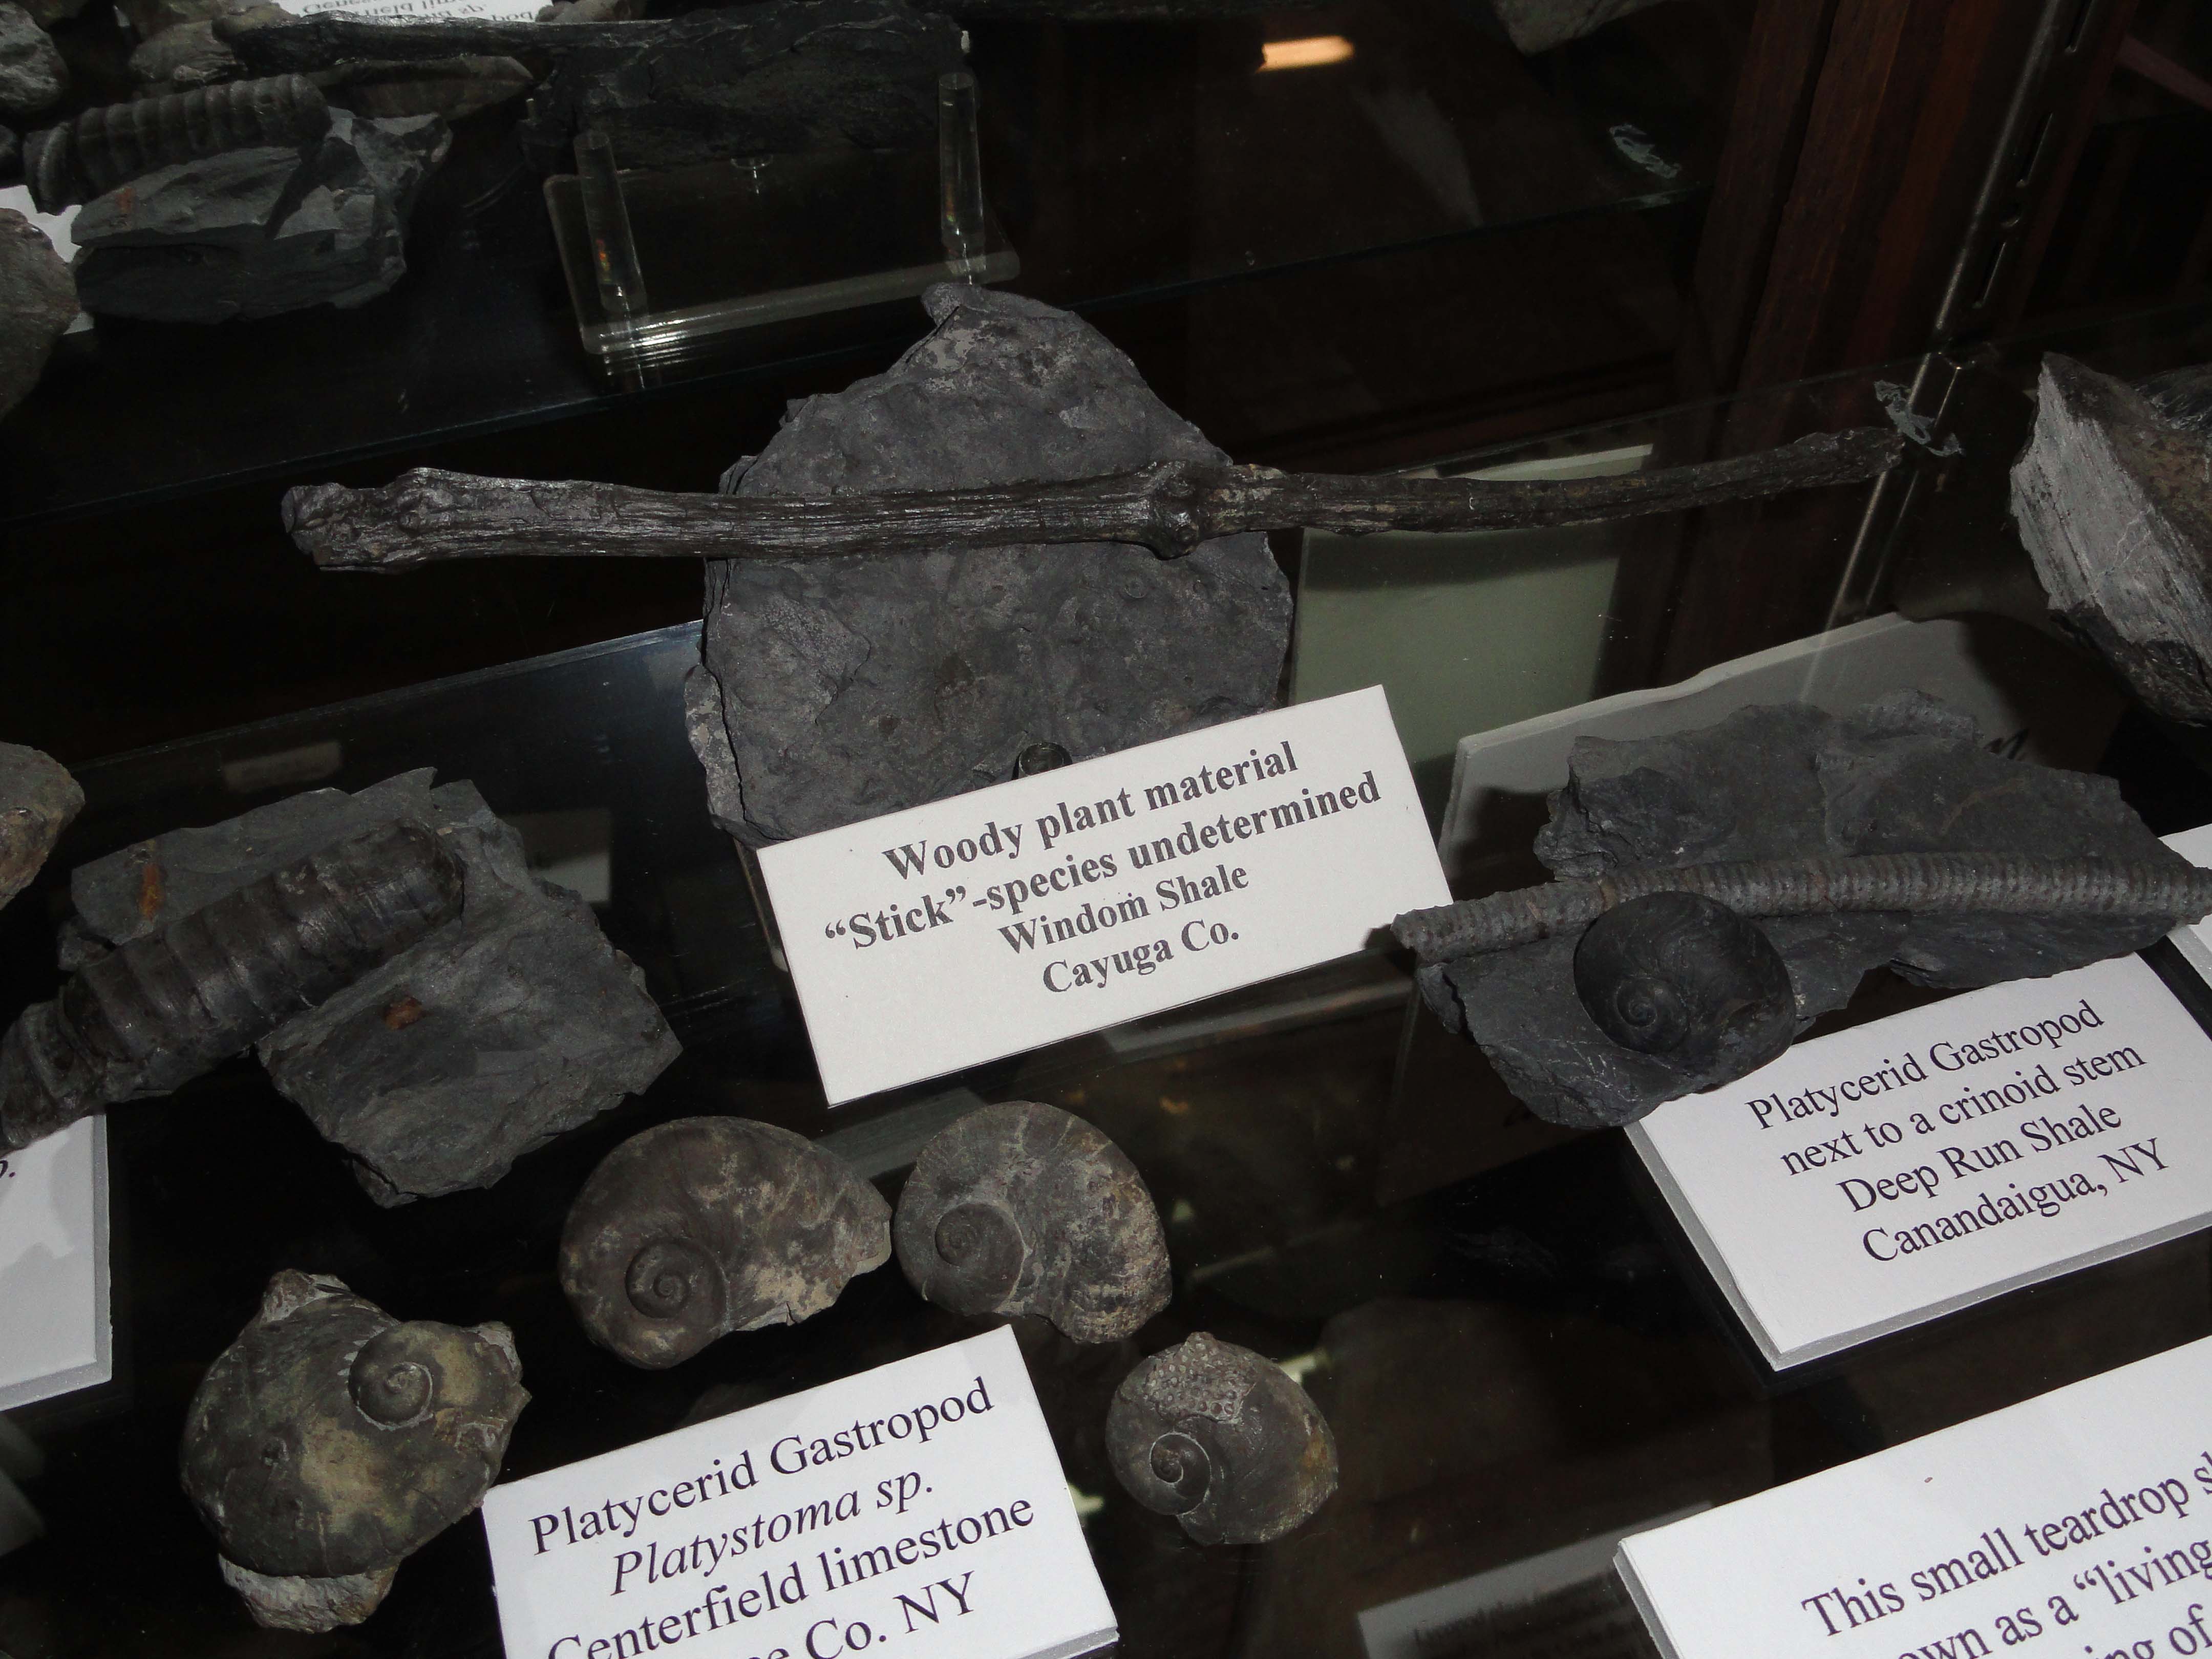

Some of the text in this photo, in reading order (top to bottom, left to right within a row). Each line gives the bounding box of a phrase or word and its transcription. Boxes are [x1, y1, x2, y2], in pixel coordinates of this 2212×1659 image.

[882, 741, 1298, 879] Woody plant material
[1128, 771, 1381, 868] undetermined
[998, 865, 1248, 953] Windom Shale
[1044, 920, 1238, 992] Cayuga Co.
[1745, 999, 2104, 1129] Platycerid Gastropod
[1781, 1048, 2146, 1175] next to a crinoid stem
[1836, 1104, 2121, 1211] Deep Run Shale
[1863, 1138, 2168, 1261] Canandaigua, NY
[529, 1376, 993, 1555] Platycerid Gastropod
[548, 1501, 1033, 1659] Centerfield limestone
[611, 1472, 931, 1596] Platystoma sp.
[1802, 1579, 1904, 1635] This
[1911, 1528, 2025, 1601] small
[2025, 1479, 2188, 1556] teardrop
[1996, 1608, 2042, 1645] as
[2048, 1596, 2078, 1625] a
[2074, 1540, 2212, 1604] “living
[806, 1572, 974, 1659] Co. NY
[2170, 1604, 2212, 1655] of
